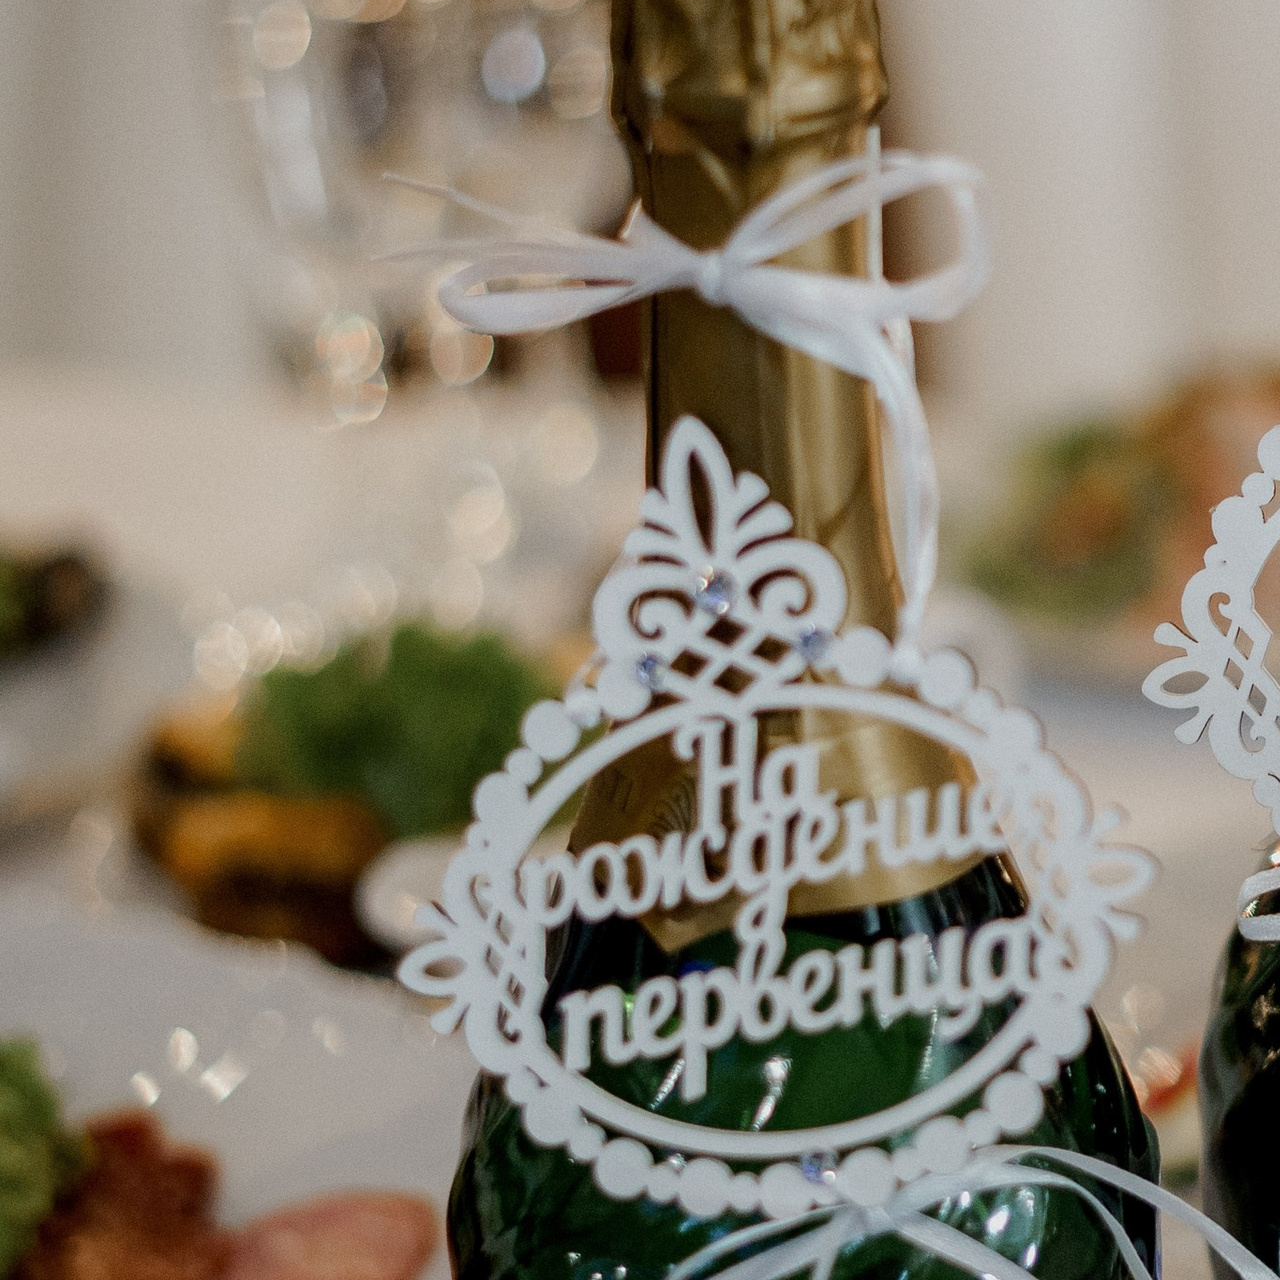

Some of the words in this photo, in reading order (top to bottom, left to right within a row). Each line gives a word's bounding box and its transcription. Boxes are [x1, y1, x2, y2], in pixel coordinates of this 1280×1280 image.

[673, 713, 840, 830] На
[520, 778, 1008, 940] рождение
[560, 918, 1038, 1102] первенца
